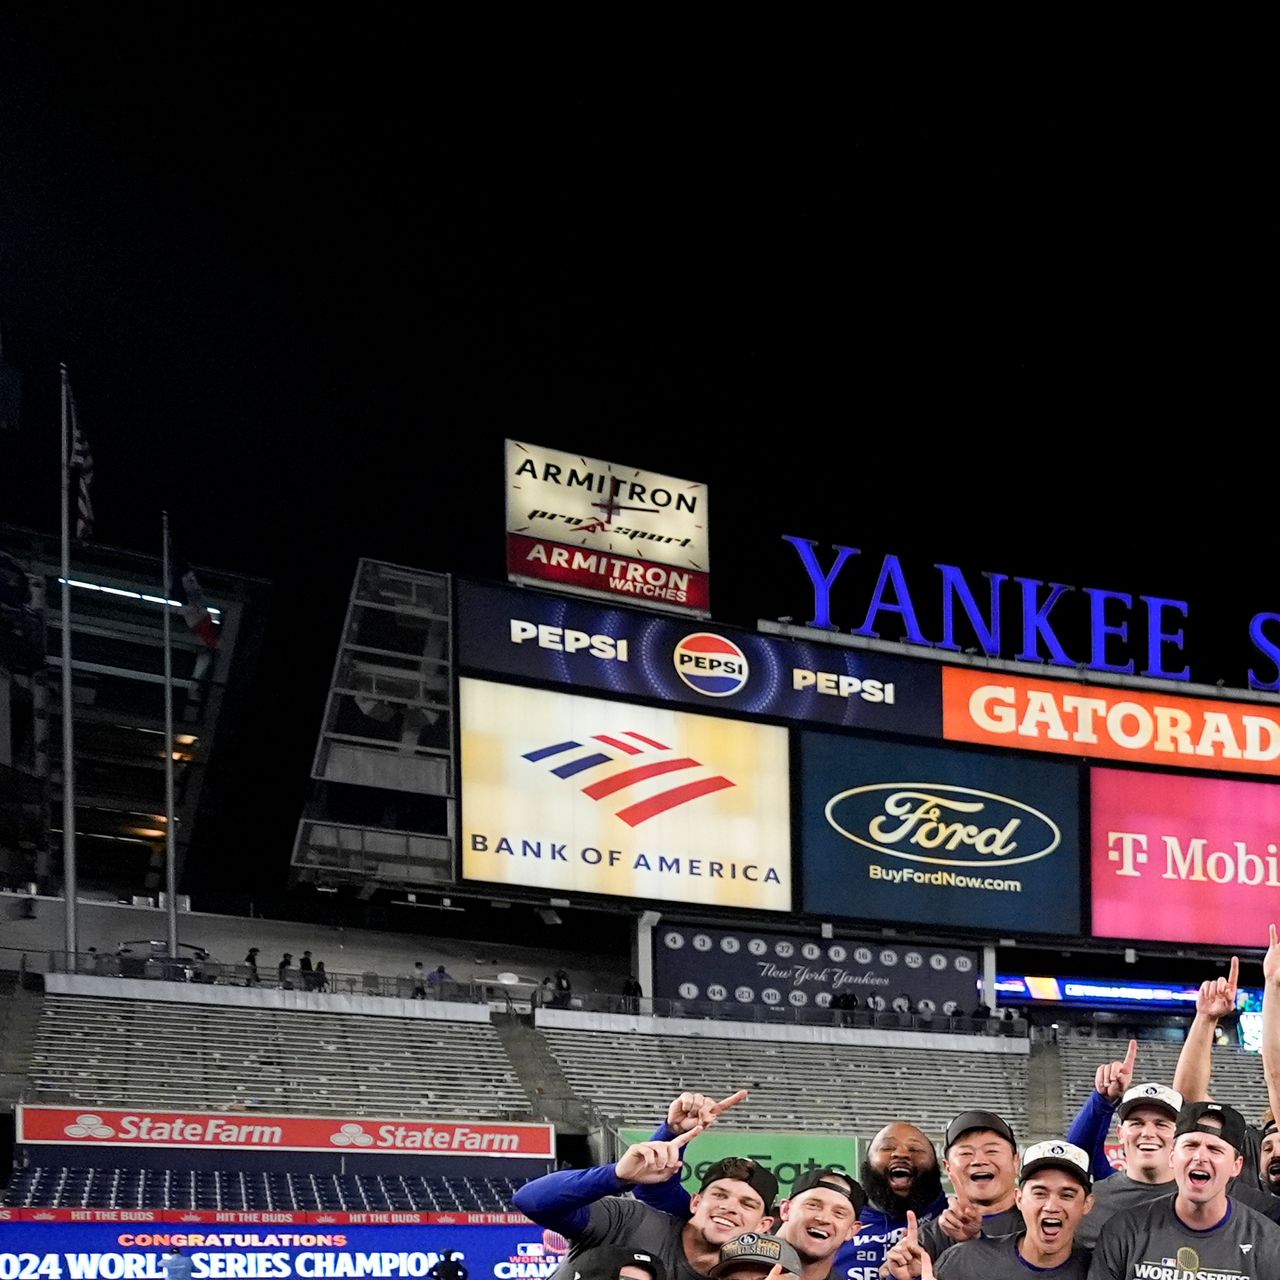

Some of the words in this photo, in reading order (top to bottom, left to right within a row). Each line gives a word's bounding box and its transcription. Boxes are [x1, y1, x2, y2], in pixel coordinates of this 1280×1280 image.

[515, 458, 697, 514] ARMITRON
[528, 510, 583, 526] pro
[614, 526, 692, 547] sport
[526, 543, 690, 590] ARMITRON
[609, 577, 688, 602] WATCHES
[781, 533, 1192, 683] YANKEE
[510, 618, 628, 662] PEPSI
[678, 653, 744, 677] PEPSI
[792, 668, 895, 705] PEPSI
[869, 790, 1020, 858] Ford
[470, 832, 569, 863] BANK
[580, 846, 622, 868] OF
[633, 853, 782, 886] AMERICA
[869, 865, 1022, 893] BuyFordNow.com
[757, 961, 793, 977] New
[791, 964, 829, 986] York
[828, 966, 890, 988] Yankees
[71, 1211, 95, 1220] HIT
[96, 1211, 118, 1220] THE
[121, 1211, 154, 1221] BUDS
[216, 1213, 235, 1222] HIT
[238, 1213, 259, 1222] THE
[262, 1213, 293, 1223] BUDS
[349, 1214, 364, 1223] HIT
[366, 1214, 389, 1223] THE
[391, 1214, 420, 1223] BUDS
[468, 1214, 482, 1223] HIT
[484, 1214, 508, 1223] THE
[508, 1214, 531, 1223] BUD
[118, 1233, 348, 1247] CONGRATULATIONS
[65, 1252, 166, 1280] WORL
[190, 1252, 291, 1280] SERIES
[509, 1255, 555, 1264] WORLD
[856, 1250, 876, 1262] 20
